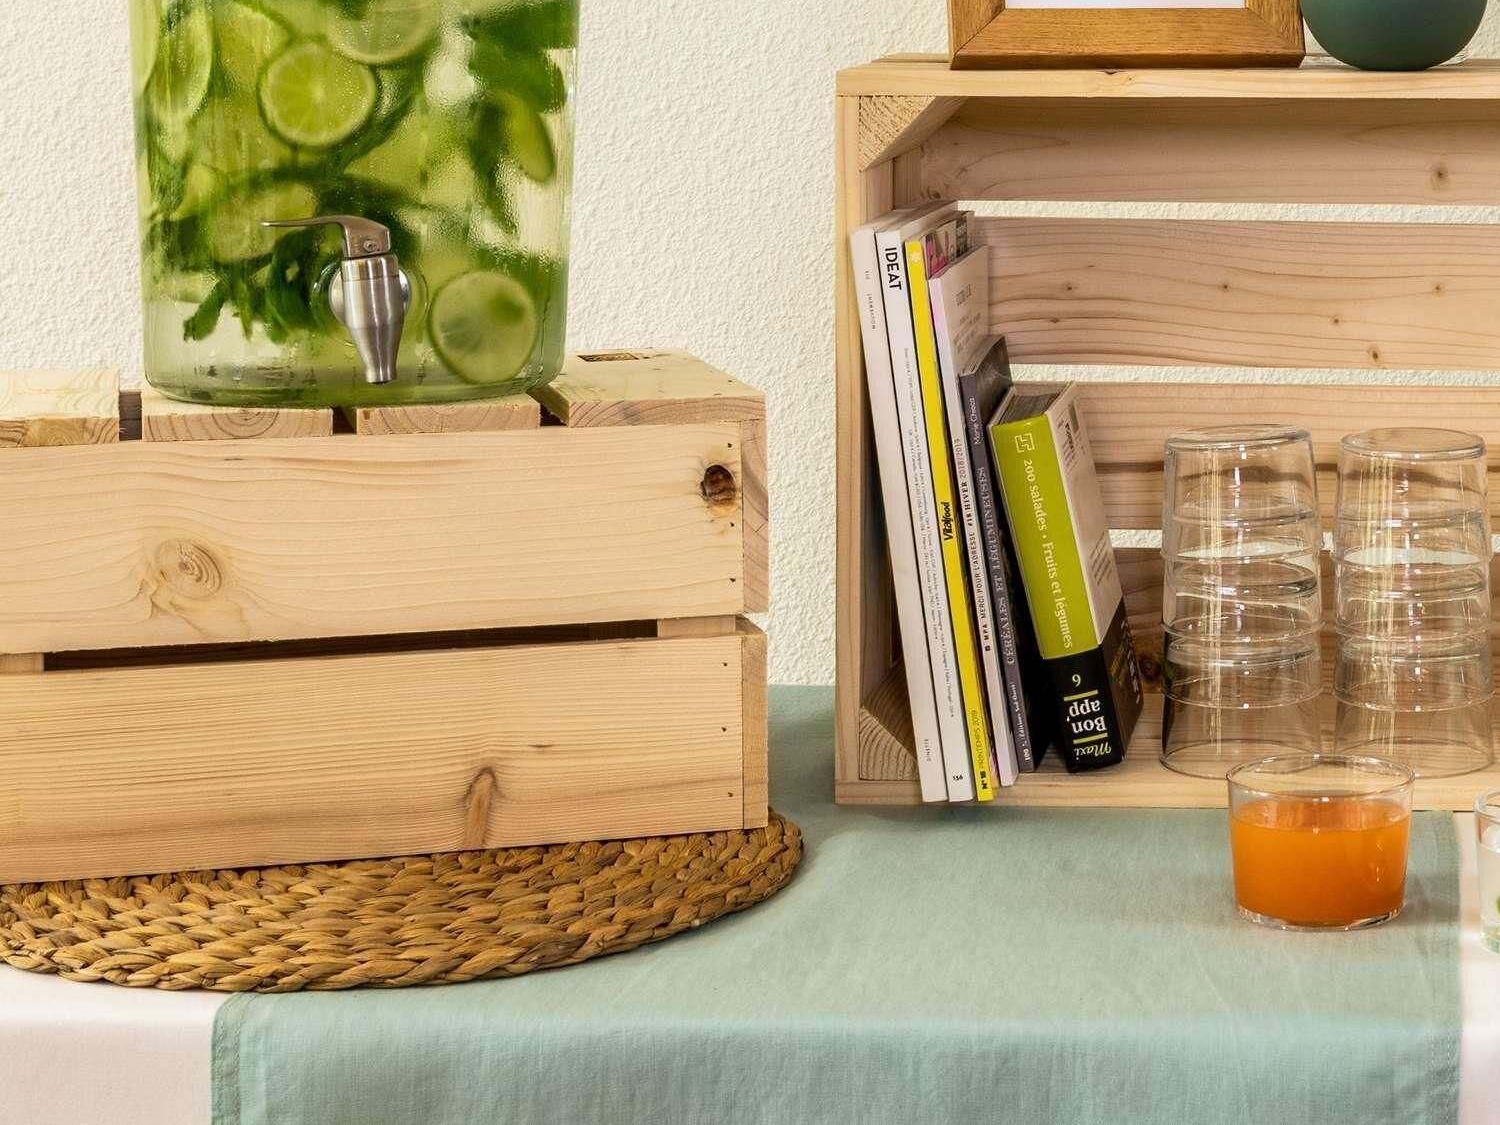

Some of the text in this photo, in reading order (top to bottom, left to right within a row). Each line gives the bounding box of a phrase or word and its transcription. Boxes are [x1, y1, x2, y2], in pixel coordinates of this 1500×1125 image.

[885, 247, 902, 290] IDEAT
[960, 481, 971, 510] HIVER
[969, 532, 981, 571] L'ADRESSE
[1023, 458, 1073, 649] 200 salades Fruits et légumes
[977, 467, 1015, 665] CÉRÉALES ET LÉGUMINEUSES
[974, 574, 983, 593] POUR
[978, 596, 986, 618] MERCI
[1071, 716, 1107, 734] Bon
[1023, 748, 1031, 761] 100
[1073, 741, 1112, 760] Maxi
